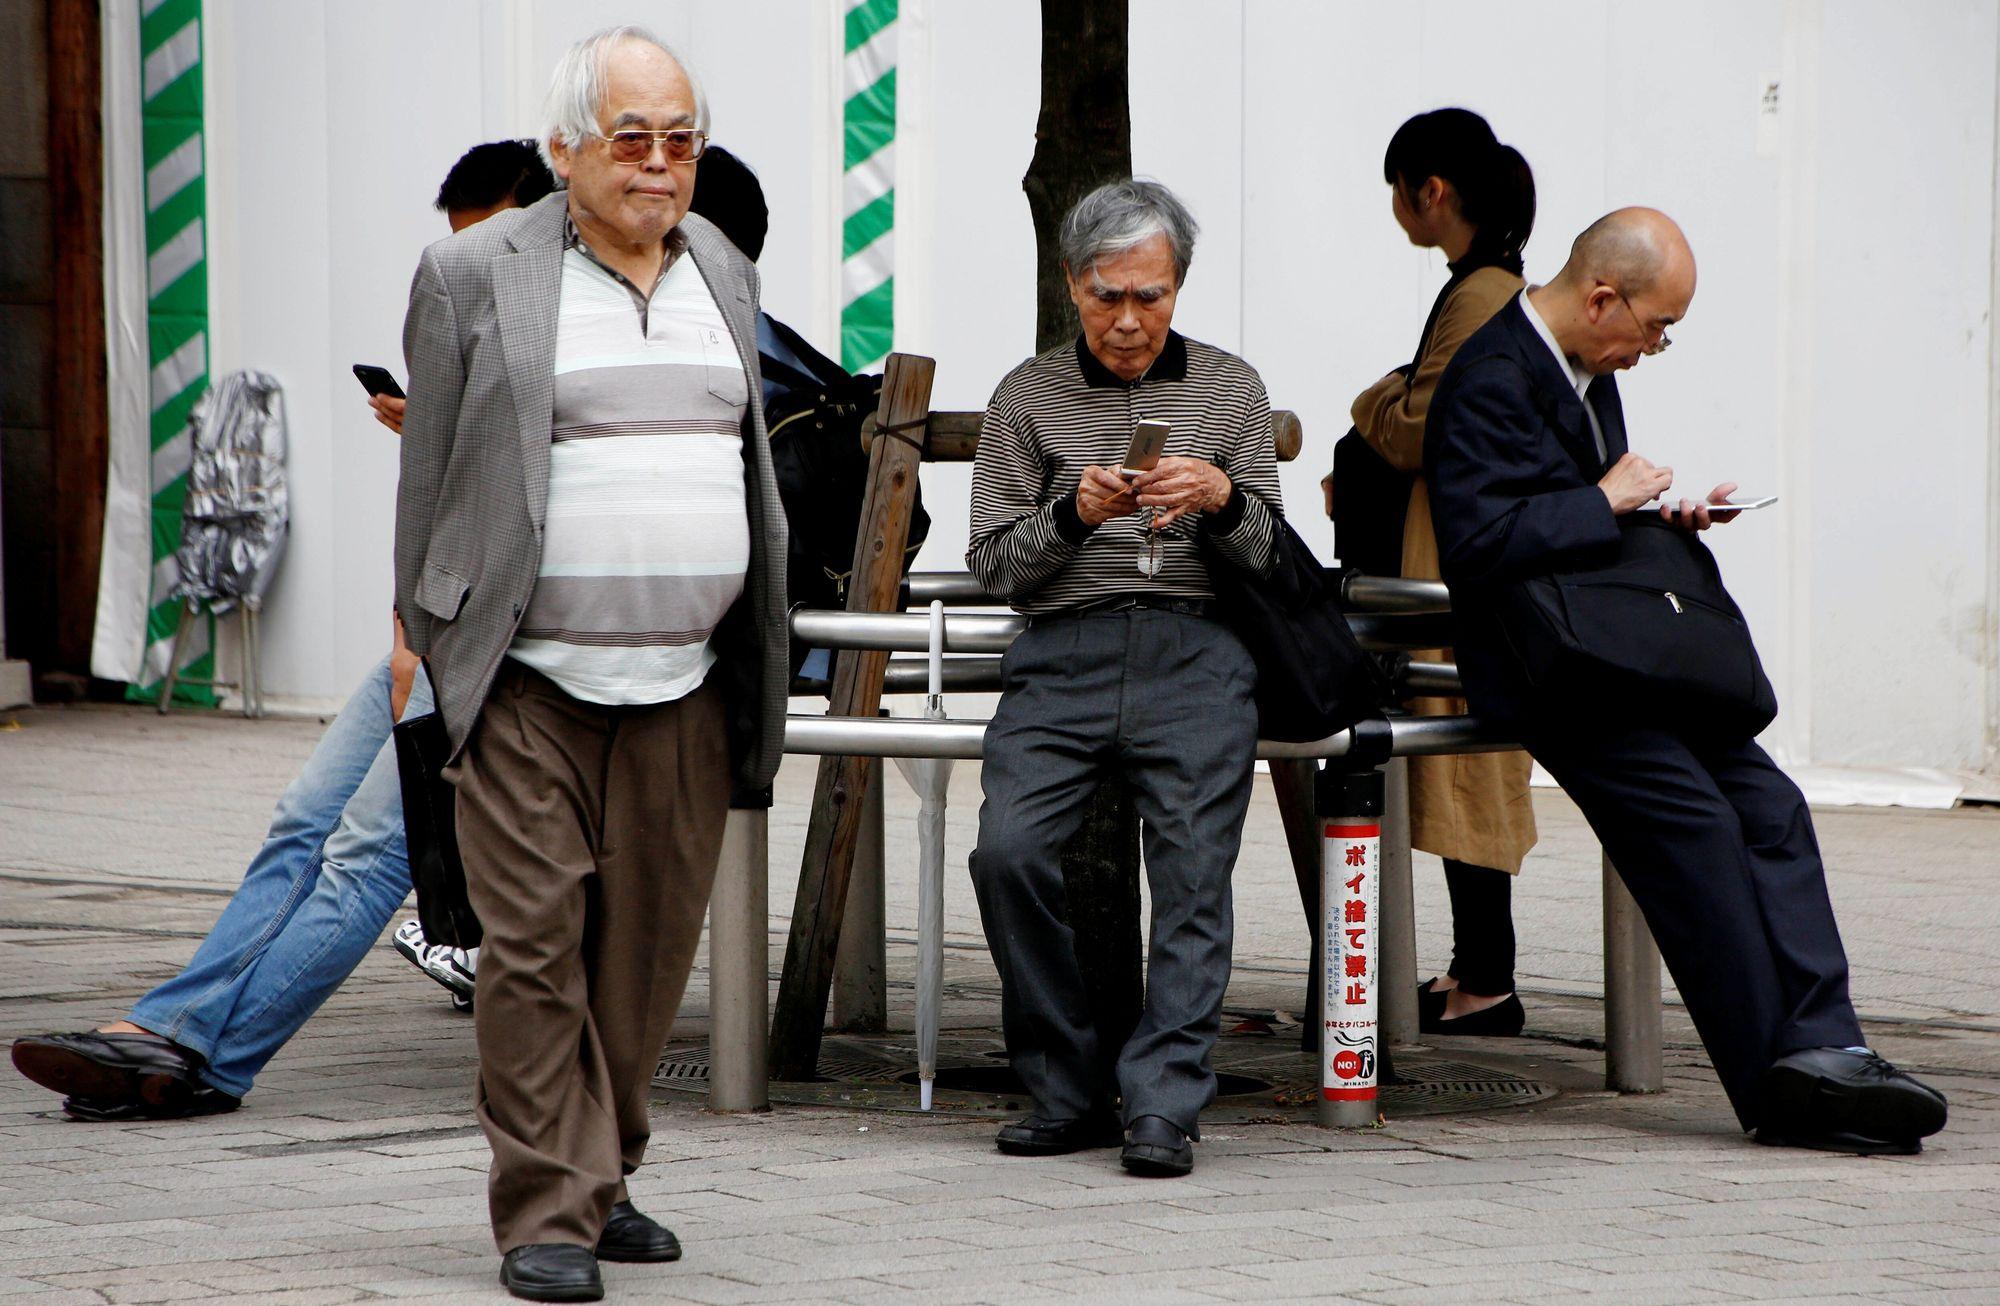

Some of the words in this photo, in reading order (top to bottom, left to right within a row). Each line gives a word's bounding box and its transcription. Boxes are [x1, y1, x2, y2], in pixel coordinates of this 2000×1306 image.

[1345, 845, 1366, 1004] ポイ捨て禁止
[1337, 1061, 1357, 1069] NO!
